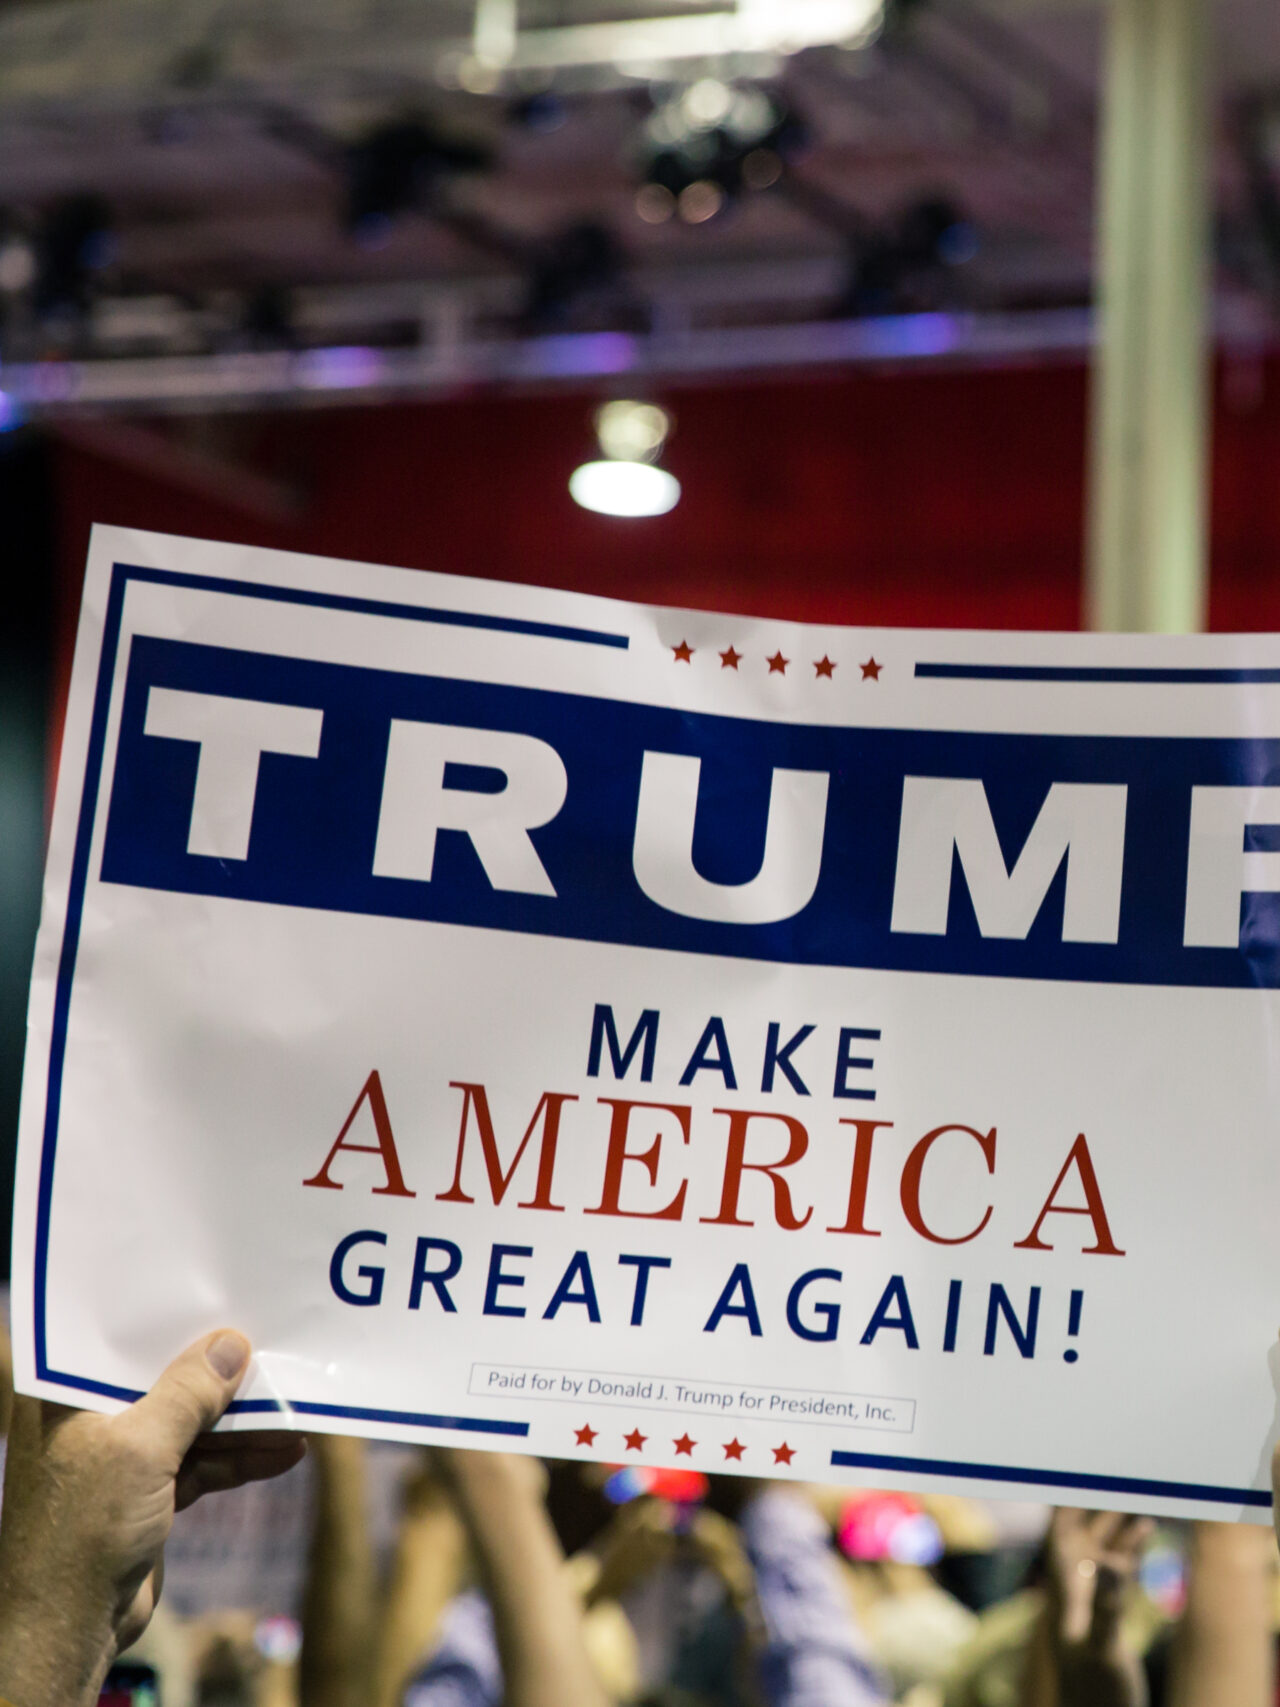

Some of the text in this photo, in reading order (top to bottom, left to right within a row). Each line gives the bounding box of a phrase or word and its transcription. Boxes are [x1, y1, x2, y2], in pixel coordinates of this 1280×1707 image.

[586, 1003, 882, 1101] MAKE
[302, 1069, 1127, 1257] AMERICA
[328, 1229, 1085, 1364] GREAT AGAIN!
[488, 1371, 897, 1422] Paid for by Donald J. Trump for President, Inc.
